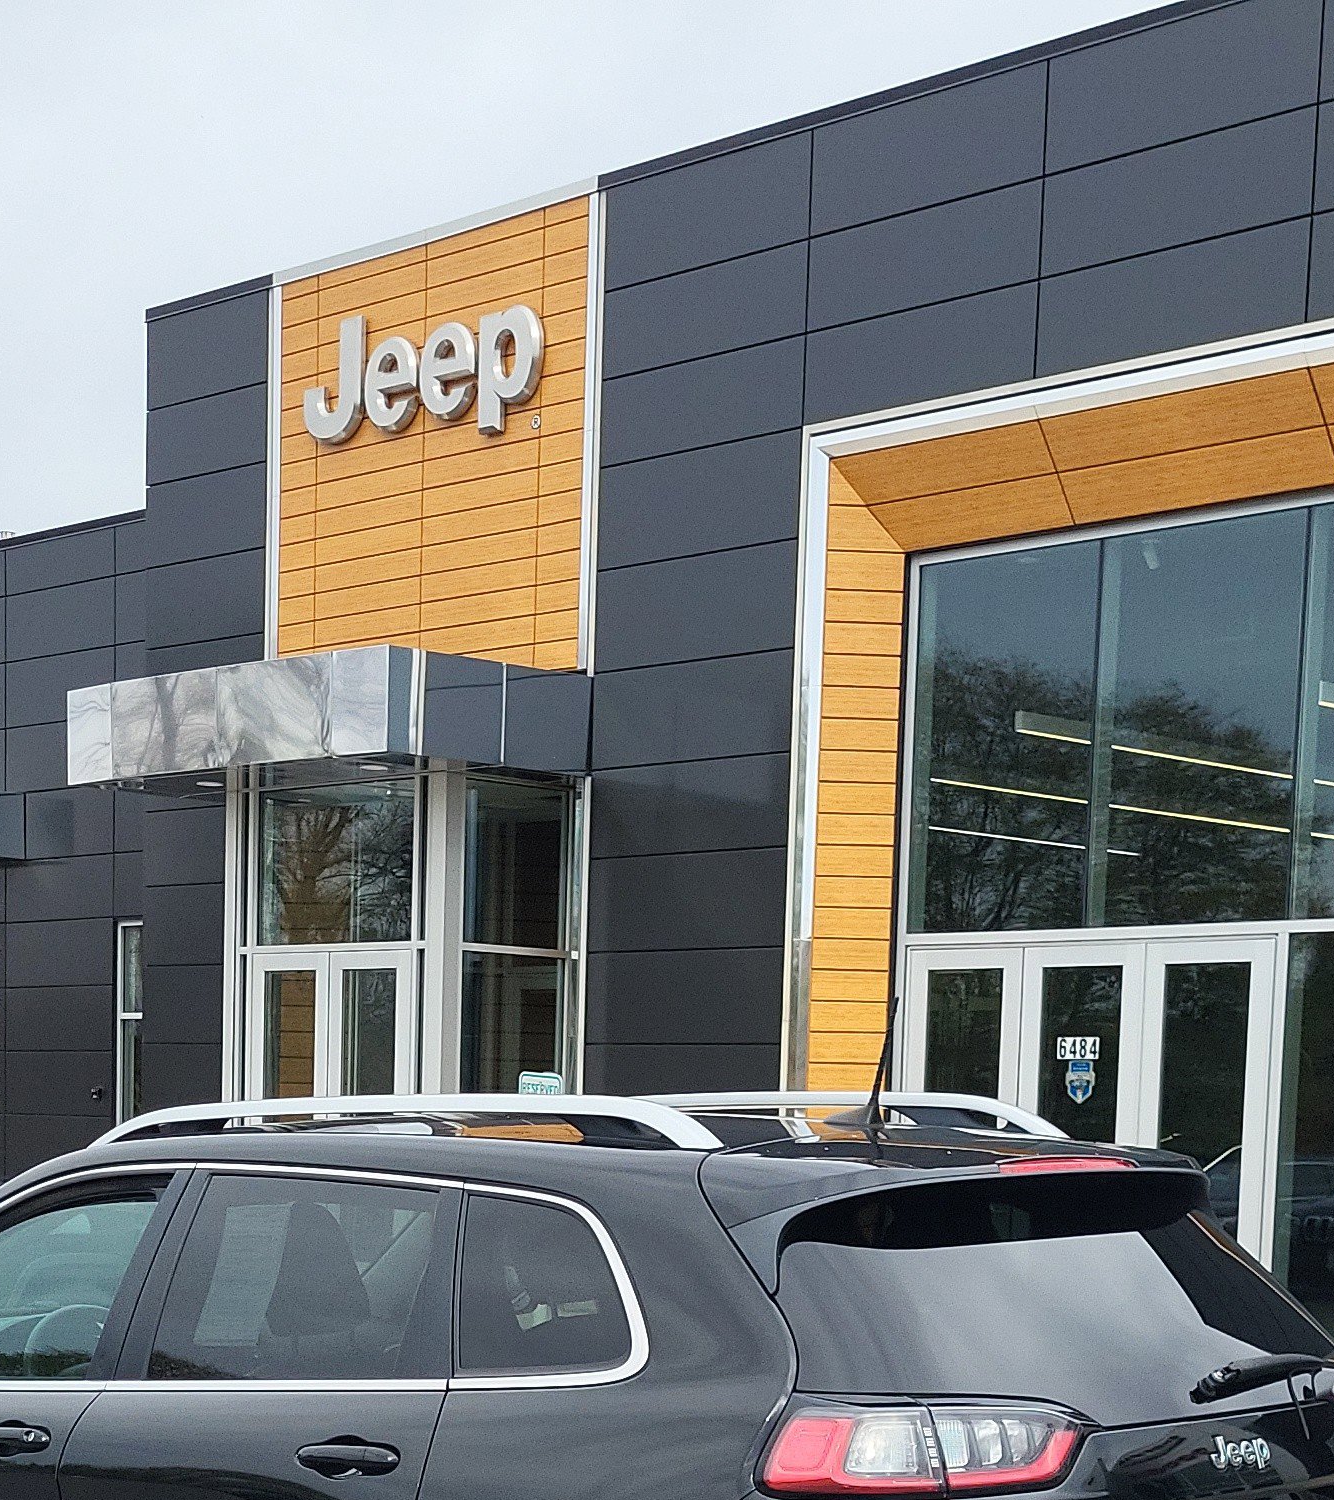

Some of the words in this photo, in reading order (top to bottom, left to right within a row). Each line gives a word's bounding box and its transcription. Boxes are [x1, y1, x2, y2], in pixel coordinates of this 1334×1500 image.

[304, 304, 545, 444] Jeep
[1059, 1038, 1098, 1058] 6484
[1210, 1435, 1271, 1470] Jeep
